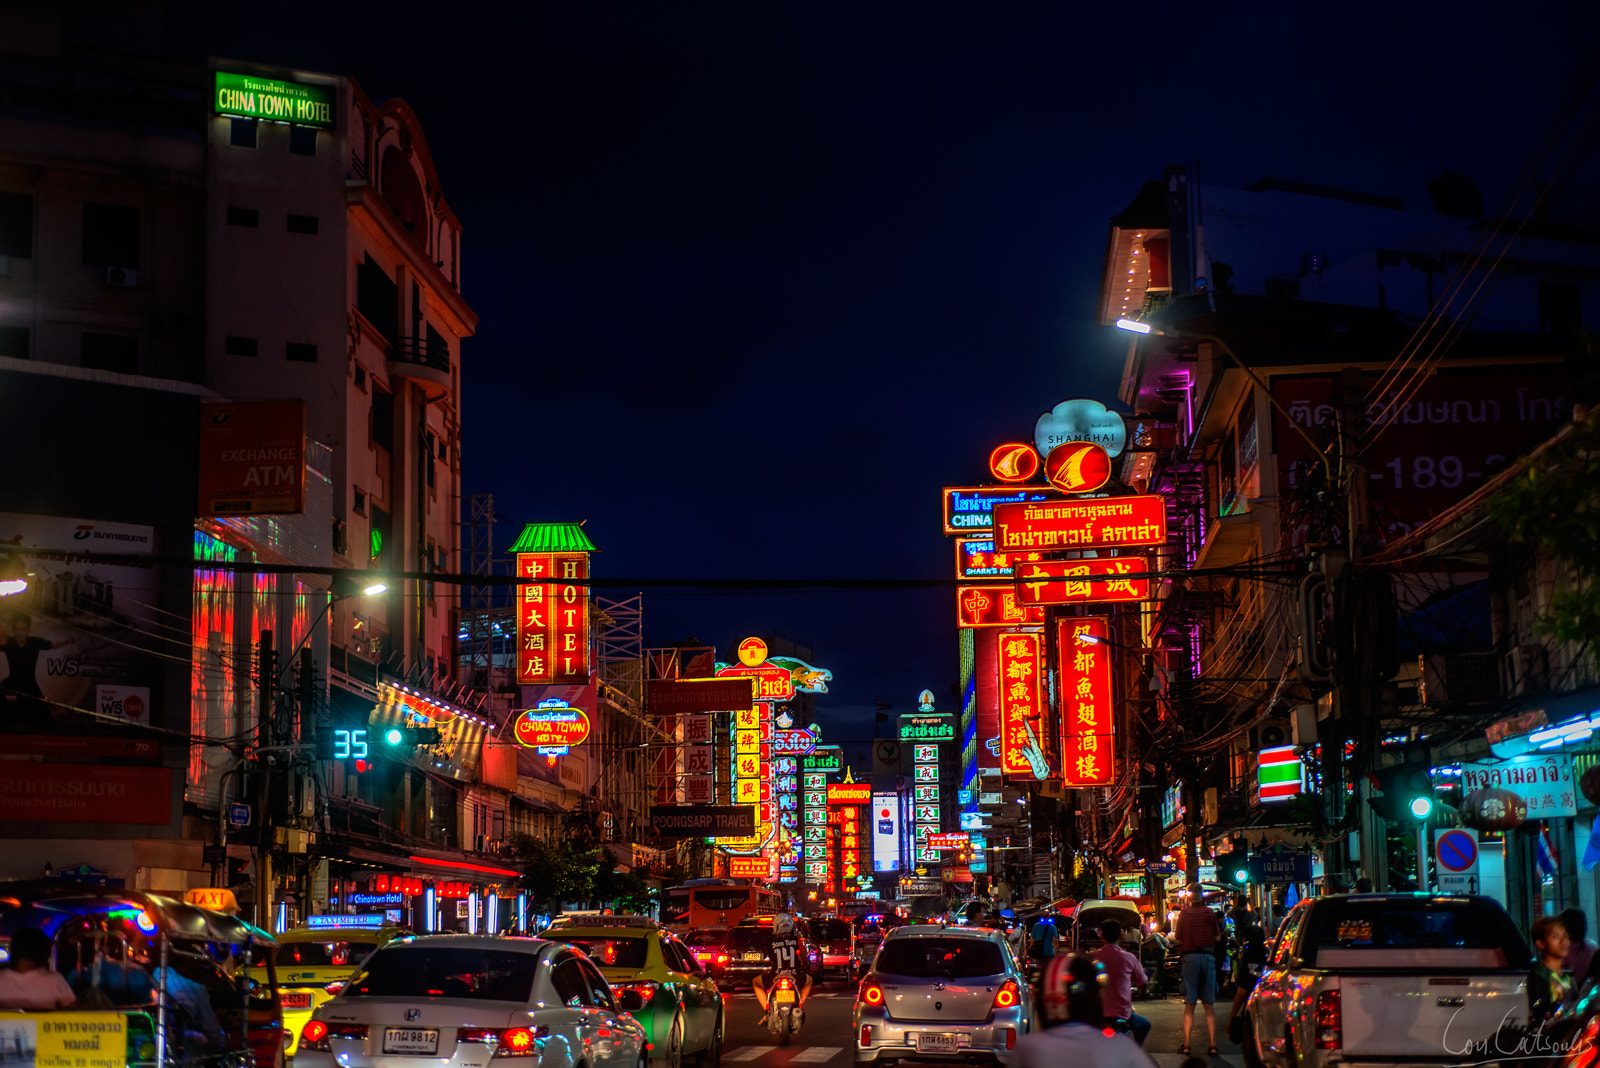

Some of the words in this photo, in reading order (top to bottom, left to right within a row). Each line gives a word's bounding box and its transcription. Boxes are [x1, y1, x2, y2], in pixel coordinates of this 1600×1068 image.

[219, 89, 255, 112] CHINA
[258, 94, 293, 117] TOWN
[297, 99, 332, 123] HOTEL
[1048, 433, 1115, 444] SHANGHAI
[221, 449, 296, 462] EXCHANGE
[243, 466, 294, 487] ATM
[951, 515, 992, 526] CHINA
[999, 524, 1094, 547] ไชน่าทาวน์
[1101, 519, 1160, 542] สกาล่า
[966, 567, 998, 575] SHARK'S
[524, 560, 546, 675] 中國大酒店
[562, 561, 578, 676] HOTEL
[47, 657, 79, 675] WS
[520, 721, 552, 733] CHINA
[556, 721, 586, 733] TOWN
[334, 729, 368, 759] 35
[536, 733, 569, 743] HOTEL
[715, 814, 750, 828] TRAVEL
[190, 892, 225, 905] TAXI
[354, 893, 385, 904] Chinatown
[386, 892, 402, 903] Hotel
[43, 1021, 122, 1034] อาคารจอดรถ
[411, 1032, 436, 1043] 9812
